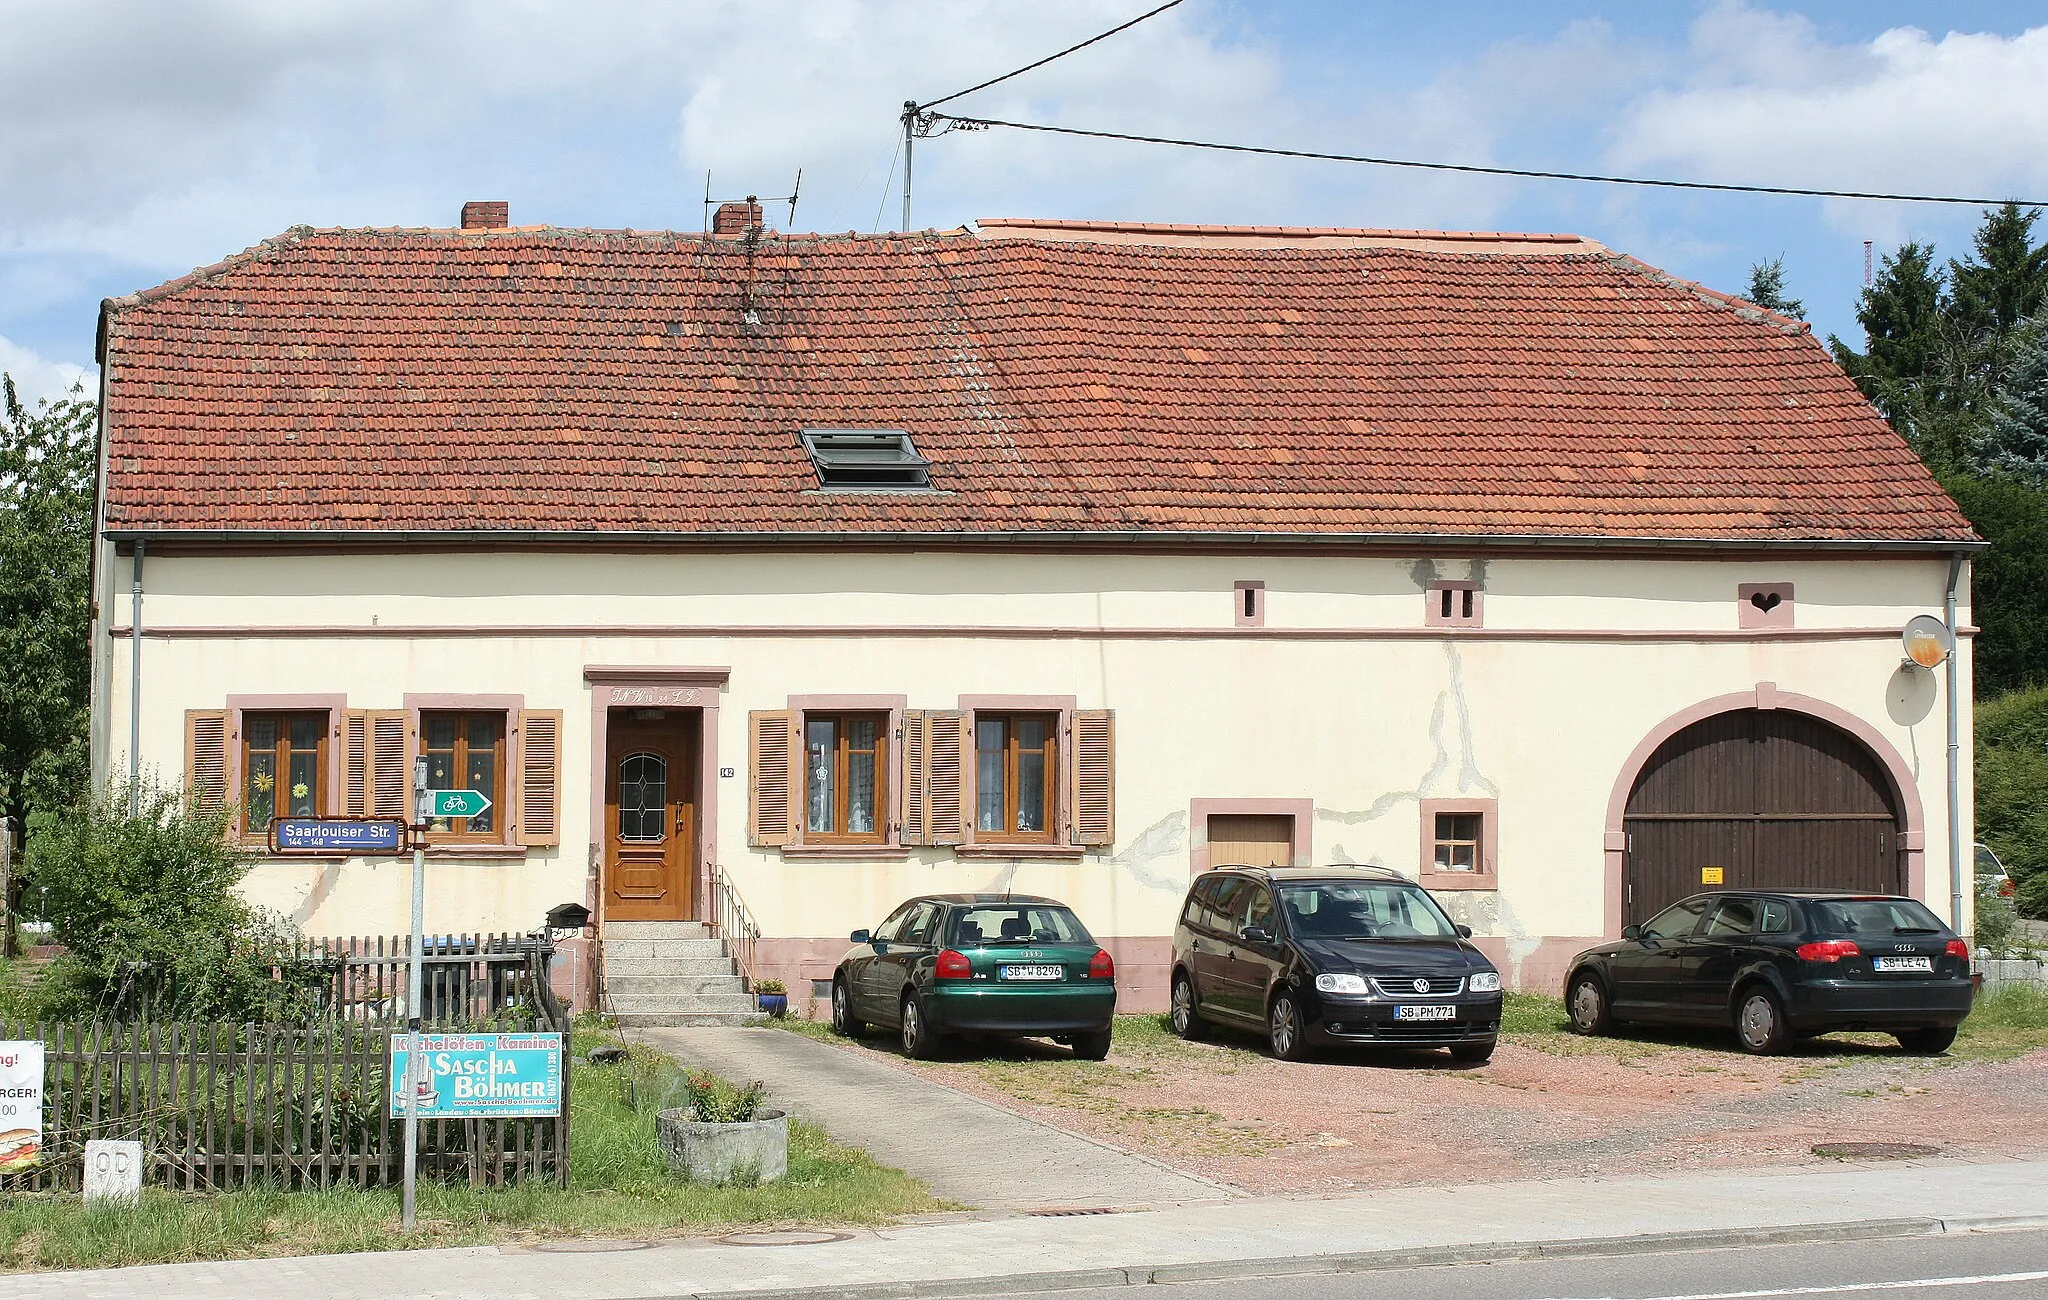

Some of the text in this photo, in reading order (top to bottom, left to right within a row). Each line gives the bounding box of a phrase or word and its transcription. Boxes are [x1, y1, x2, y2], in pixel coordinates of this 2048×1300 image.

[721, 768, 733, 776] 142
[285, 825, 391, 837] Saarlouiser Str.
[288, 838, 302, 846] 144
[310, 838, 324, 846] 148
[1883, 957, 1927, 968] SB LE 42
[1007, 966, 1061, 977] SB W 8296
[1401, 1007, 1414, 1018] SB
[394, 1035, 558, 1051] Kchelöfen Kamine
[453, 1097, 557, 1106] www.Sascha-Boehmer.de
